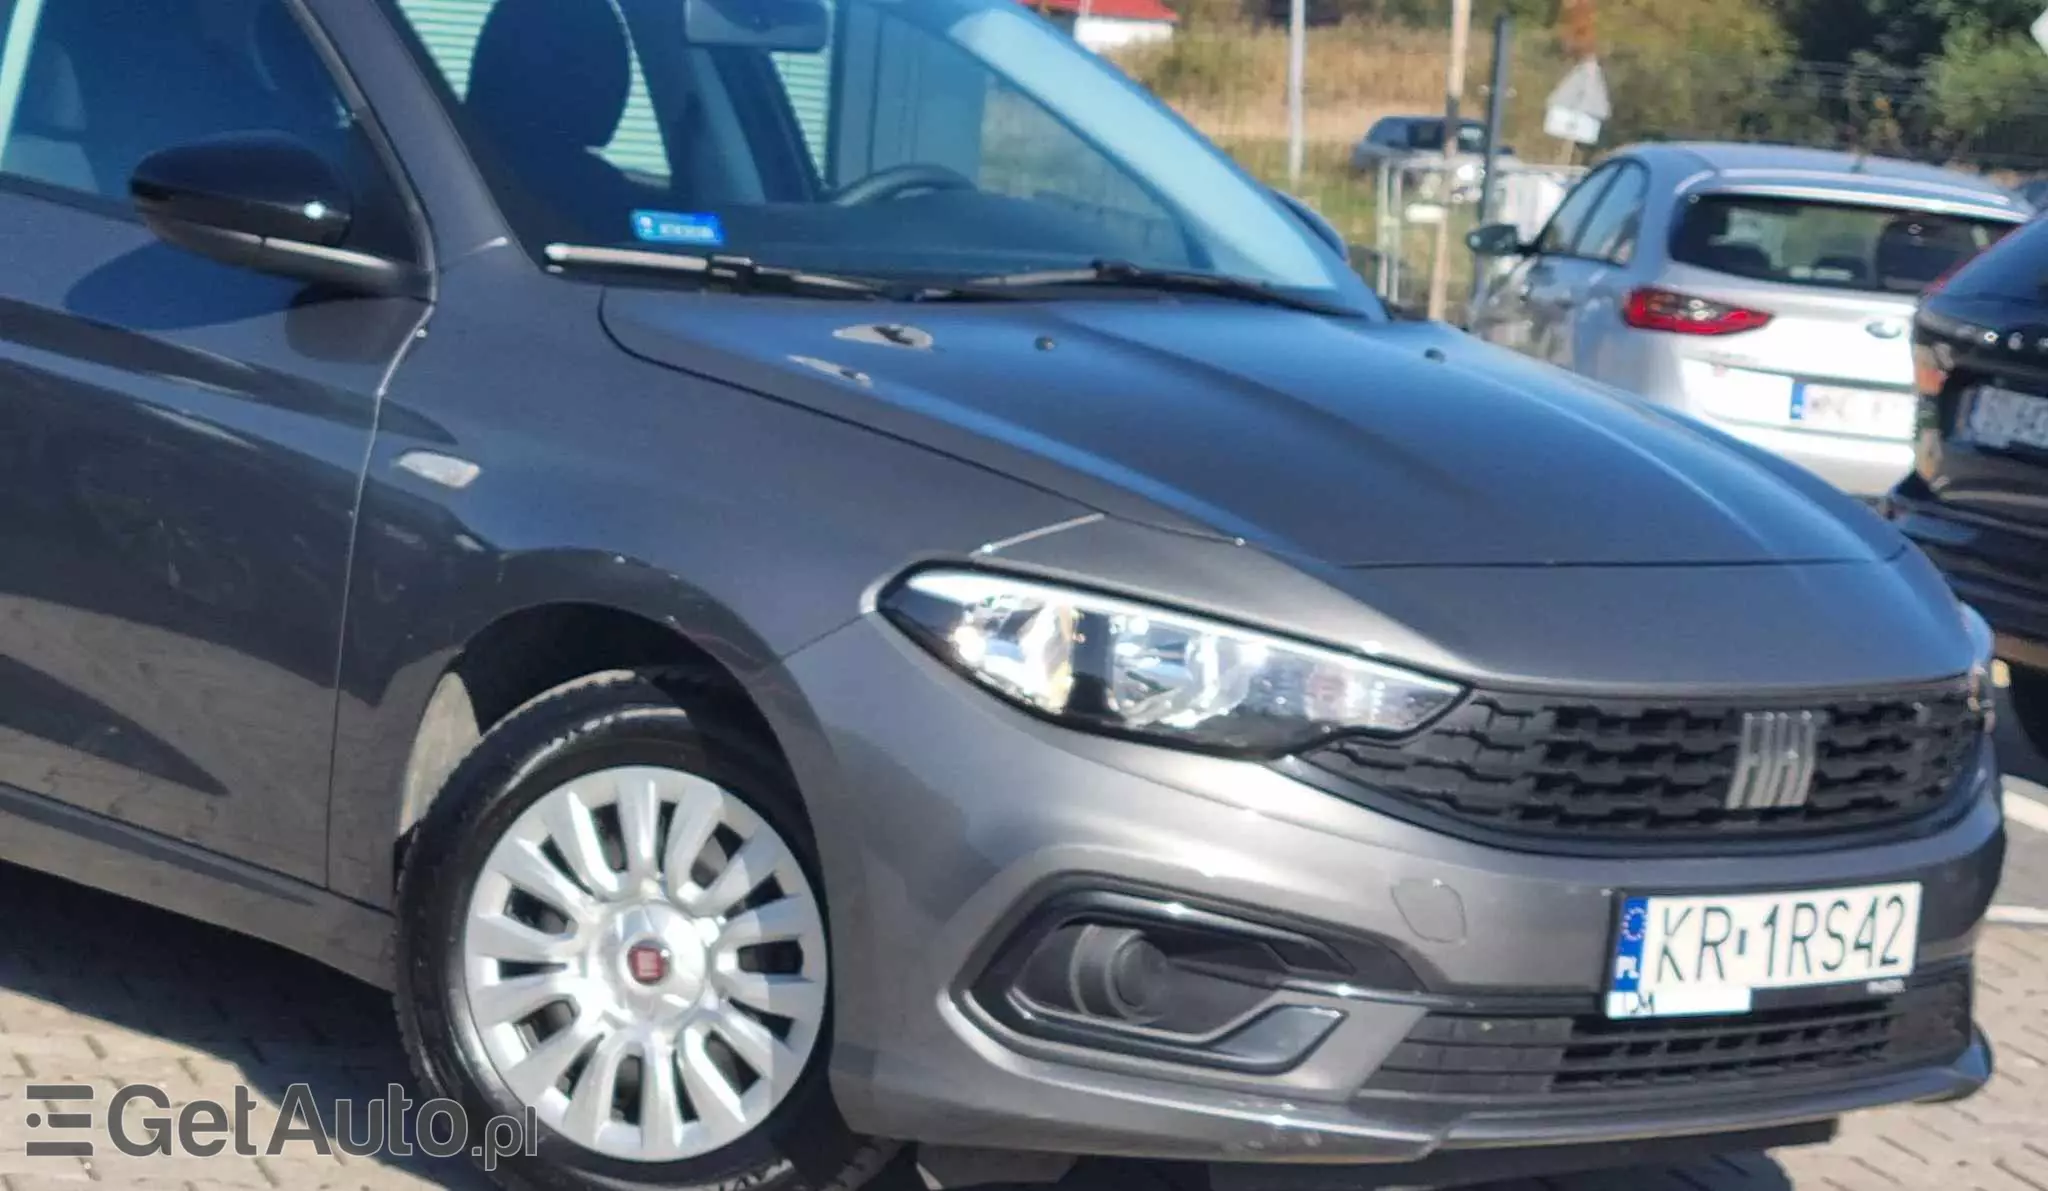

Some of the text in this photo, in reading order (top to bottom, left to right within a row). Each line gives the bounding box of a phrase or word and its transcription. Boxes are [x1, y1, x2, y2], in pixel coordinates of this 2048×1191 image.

[1725, 710, 1827, 809] FIAT
[1656, 895, 1906, 982] KR 1RS42
